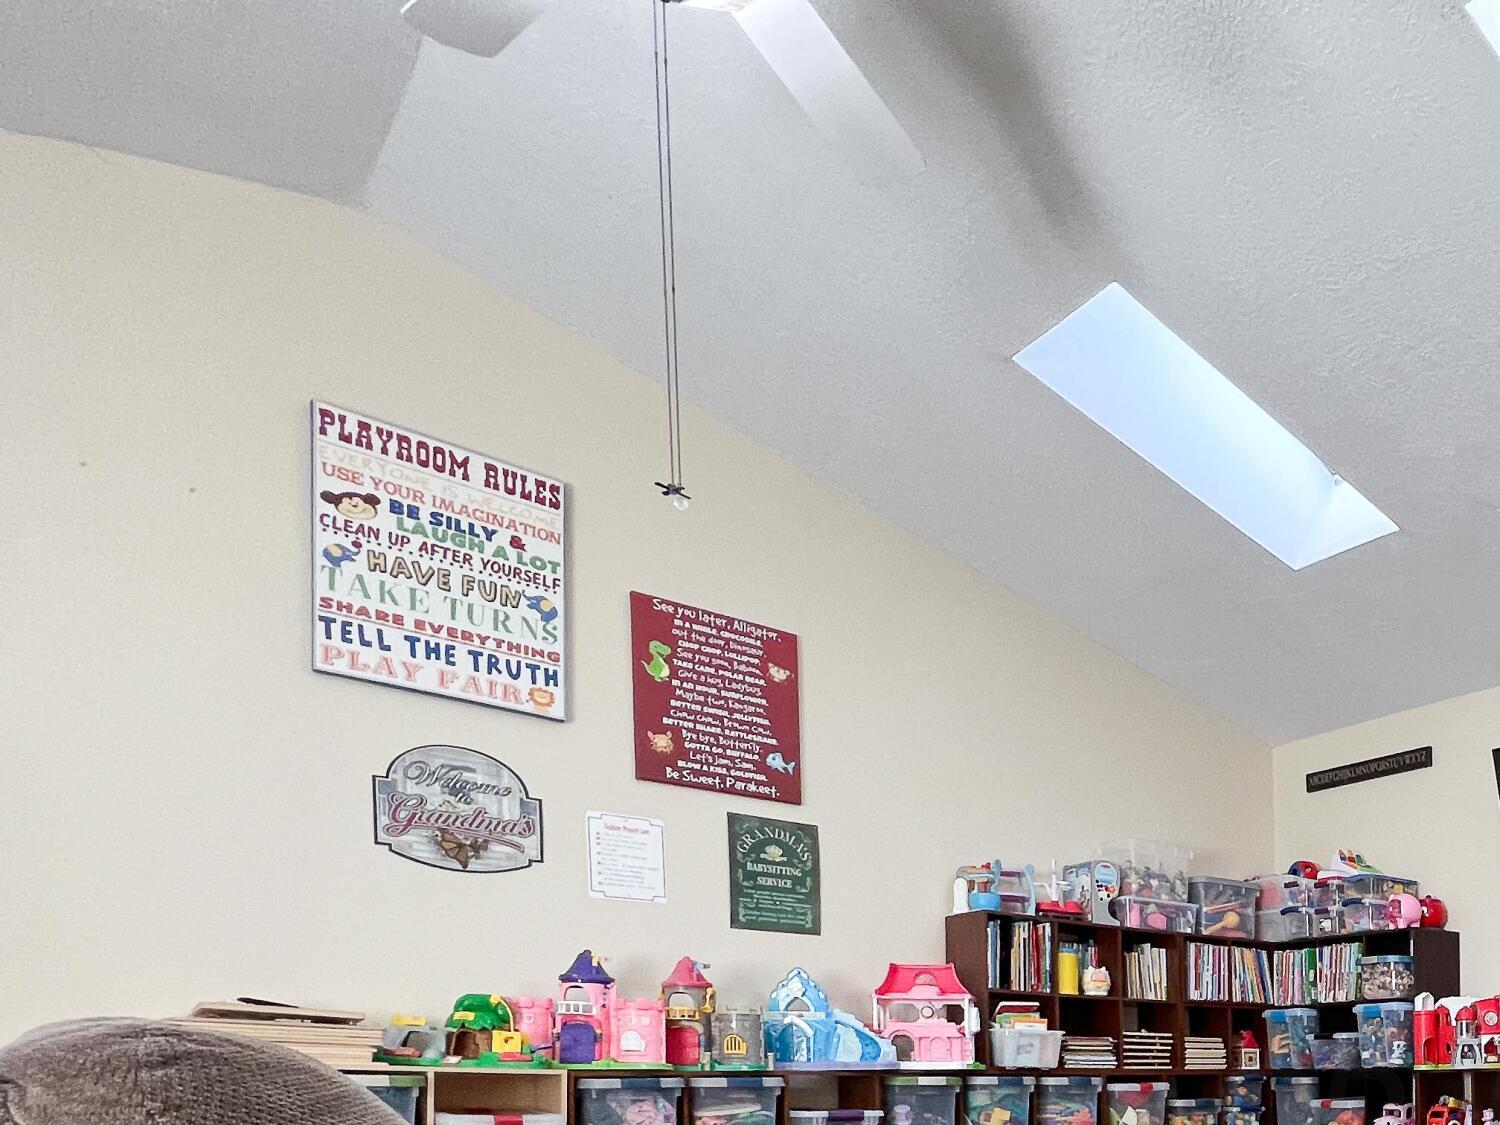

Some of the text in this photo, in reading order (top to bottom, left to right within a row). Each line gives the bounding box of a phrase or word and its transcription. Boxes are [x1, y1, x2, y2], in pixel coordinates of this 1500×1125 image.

[319, 408, 561, 511] PLAYROOM RULES
[321, 462, 561, 545] USE YOUR IMAGINATION
[388, 498, 528, 552] BE SILLY &
[320, 513, 561, 591] CLEAN UP AFTER YOURSELF
[396, 515, 561, 574] LAUGH A LOT
[366, 549, 521, 608] HAVE FUN
[320, 565, 558, 644] TAKE TURNS
[652, 599, 674, 614] See
[674, 607, 695, 618] you
[699, 611, 731, 629] later,
[320, 597, 561, 663] SHARE EVERYTHING
[692, 632, 706, 642] the
[319, 616, 559, 687] TELL THE TRUTH
[676, 648, 693, 658] See
[695, 652, 709, 664] you
[678, 640, 699, 649] CHOP
[321, 645, 424, 682] PLAY
[672, 659, 693, 668] TAKE
[719, 670, 744, 681] POLAR
[678, 670, 697, 679] Give
[670, 700, 702, 711] BETTER
[675, 689, 704, 702] Maybe
[663, 717, 694, 729] BETTER
[682, 729, 697, 740] Bye
[684, 742, 710, 751] GOTTA
[690, 751, 713, 763] Let's
[677, 760, 701, 769] BLOW
[404, 760, 512, 797] Welcome
[666, 767, 679, 779] Be
[726, 778, 780, 798] Parakeet.
[455, 792, 473, 805] to
[383, 791, 535, 839] Grandma's
[737, 826, 811, 861] GRANDMA'S
[747, 862, 802, 877] BABYSITTING
[756, 876, 793, 889] SERVICE
